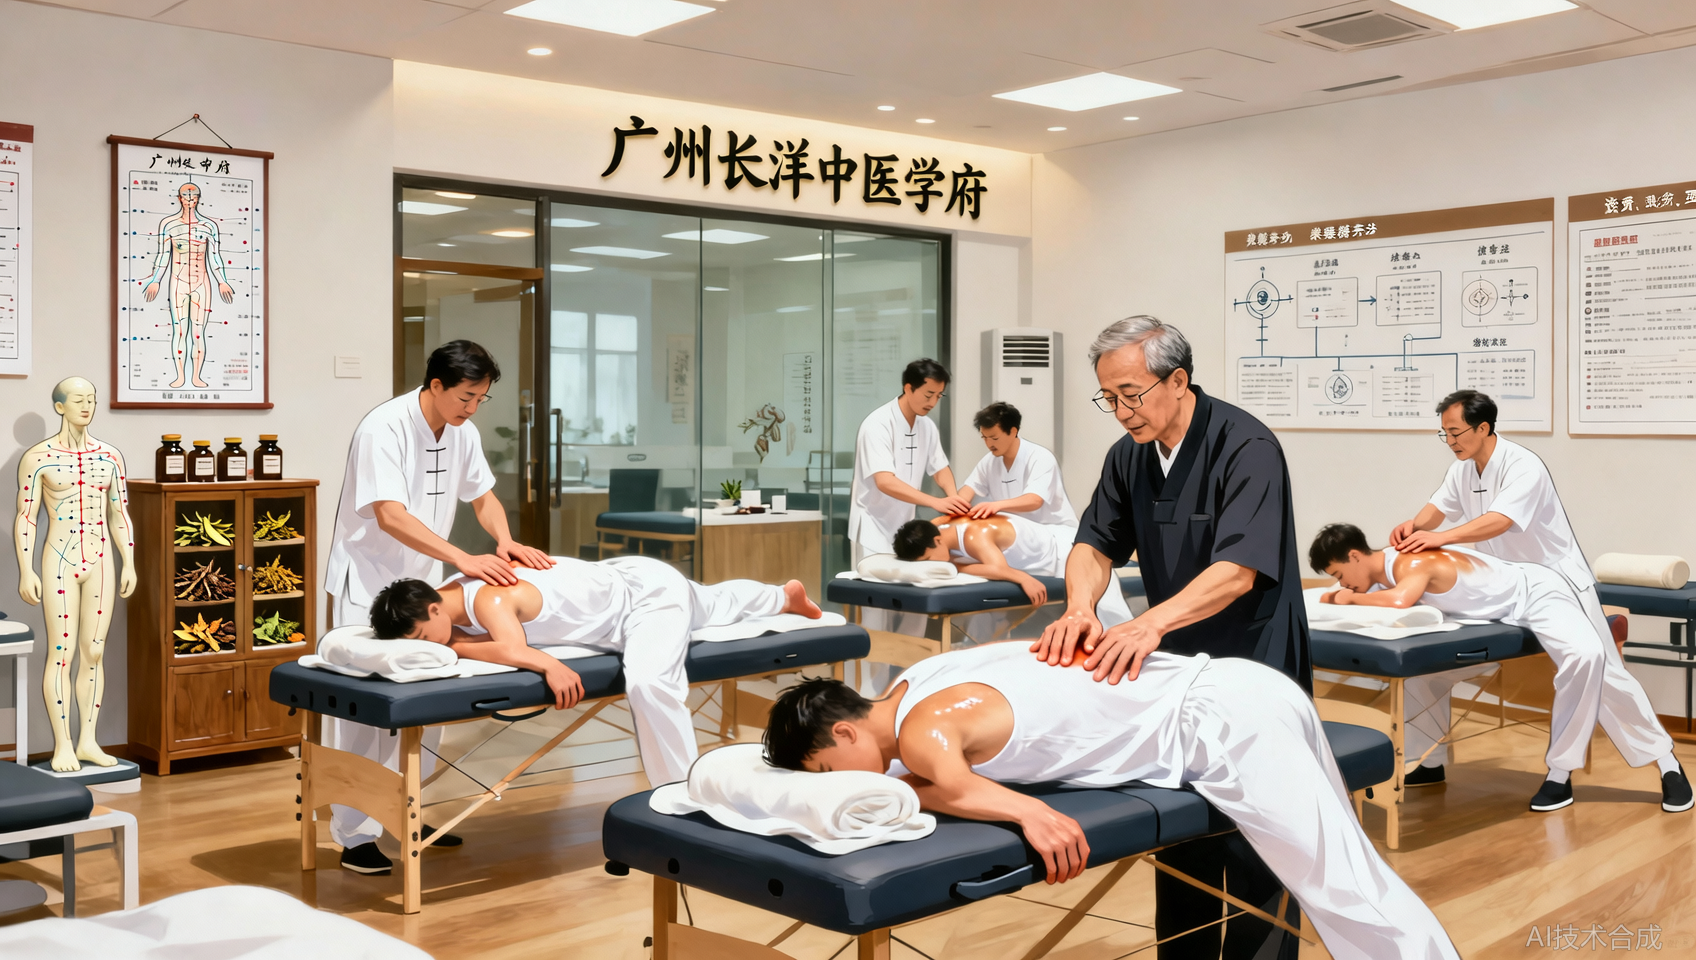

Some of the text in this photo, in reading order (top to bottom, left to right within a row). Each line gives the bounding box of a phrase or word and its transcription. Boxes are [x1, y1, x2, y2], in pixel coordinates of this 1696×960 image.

[601, 115, 988, 220] 广州长洋中医学府
